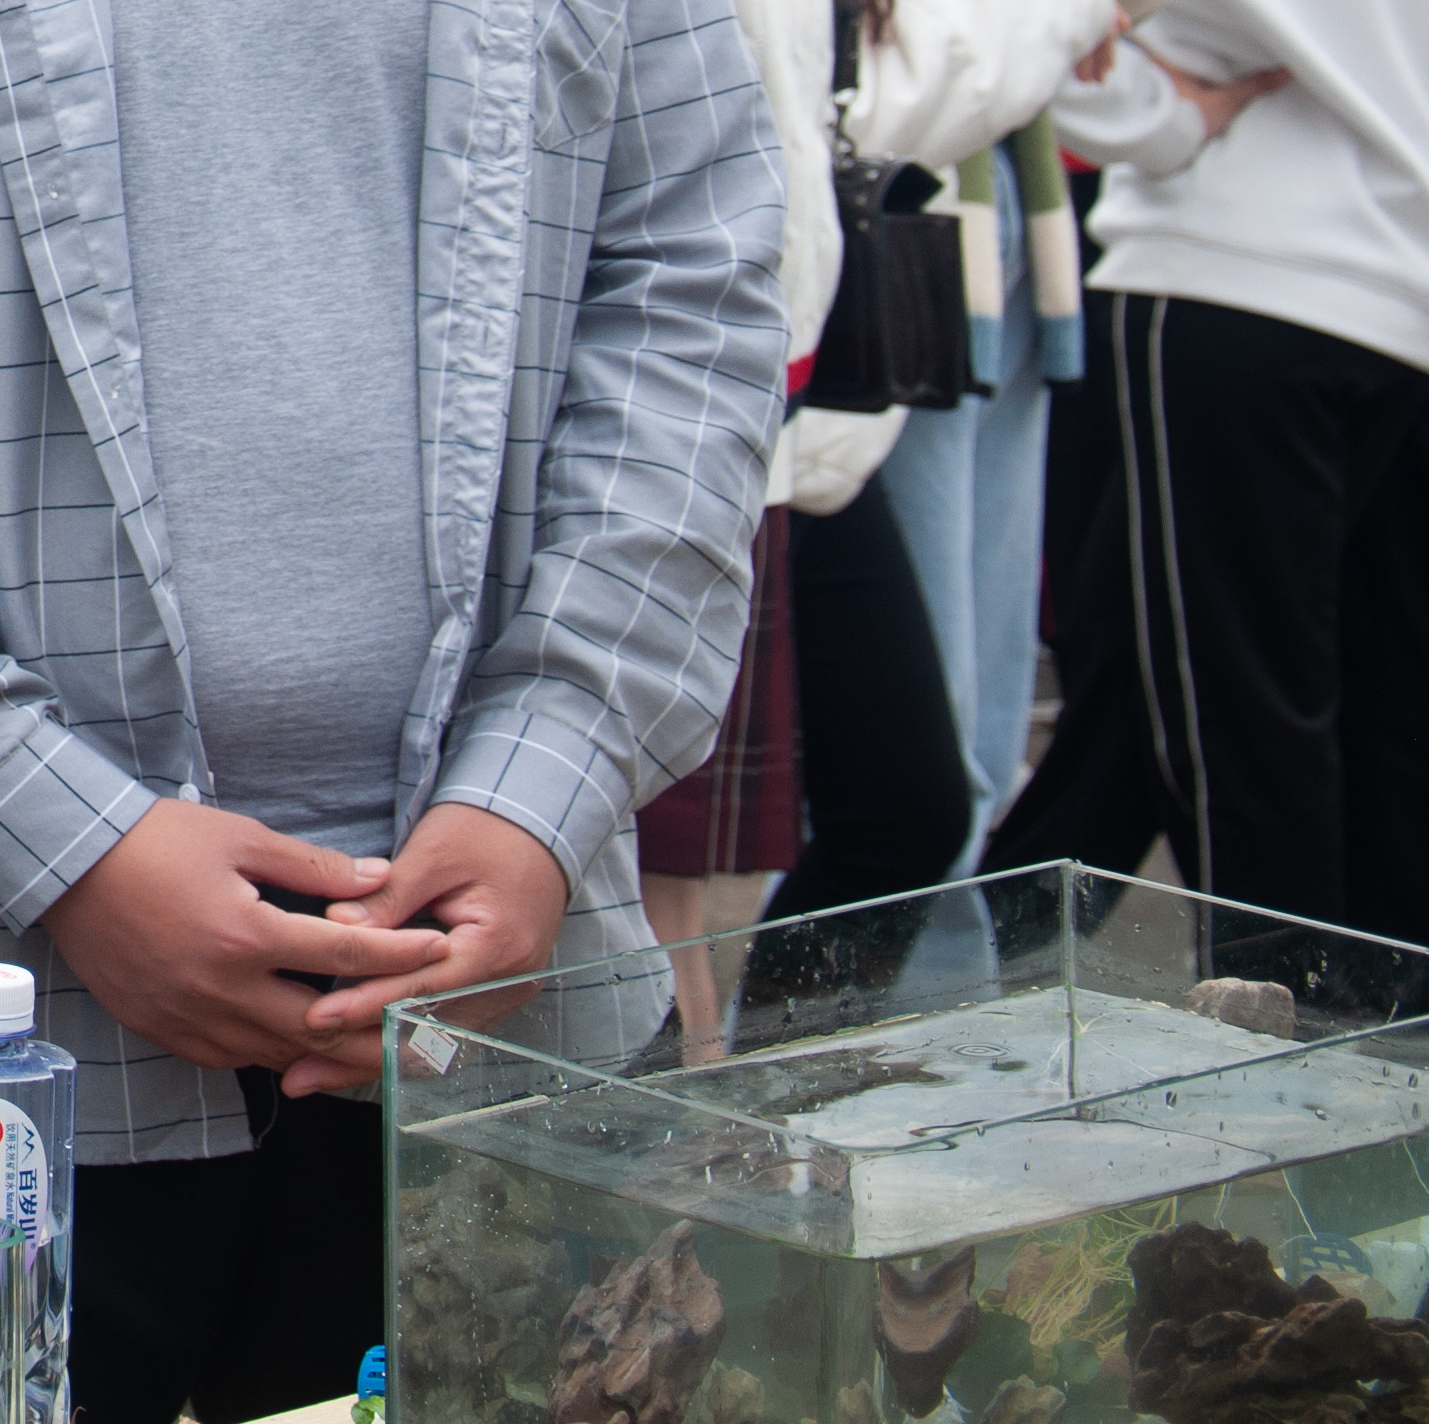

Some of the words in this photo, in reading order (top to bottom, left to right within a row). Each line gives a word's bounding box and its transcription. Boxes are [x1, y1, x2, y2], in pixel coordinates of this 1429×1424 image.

[5, 1123, 16, 1191] 饮用天然矿泉水
[18, 1167, 38, 1240] 百岁山
